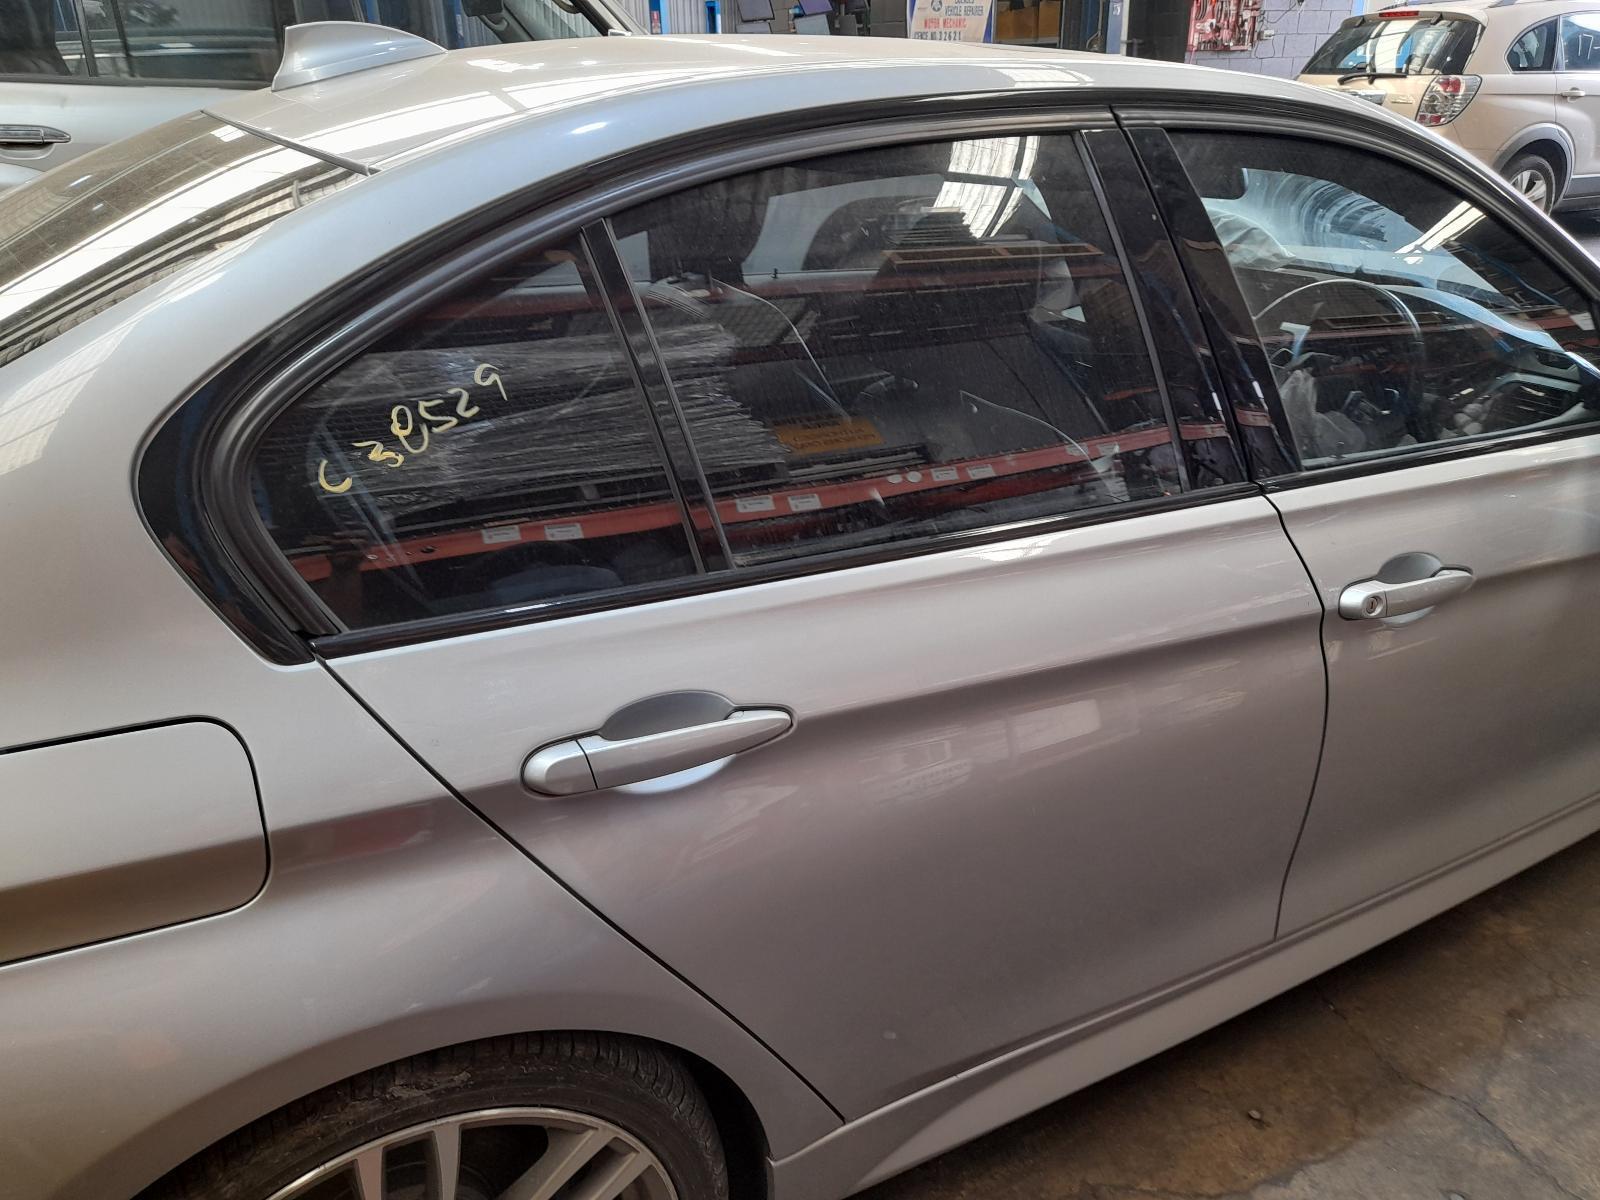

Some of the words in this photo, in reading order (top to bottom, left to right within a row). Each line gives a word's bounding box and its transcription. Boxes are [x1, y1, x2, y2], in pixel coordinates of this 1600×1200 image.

[944, 5, 962, 16] VEHICLE
[924, 17, 940, 29] MOTOR
[943, 17, 967, 29] MECHANIC
[938, 31, 961, 41] 32621
